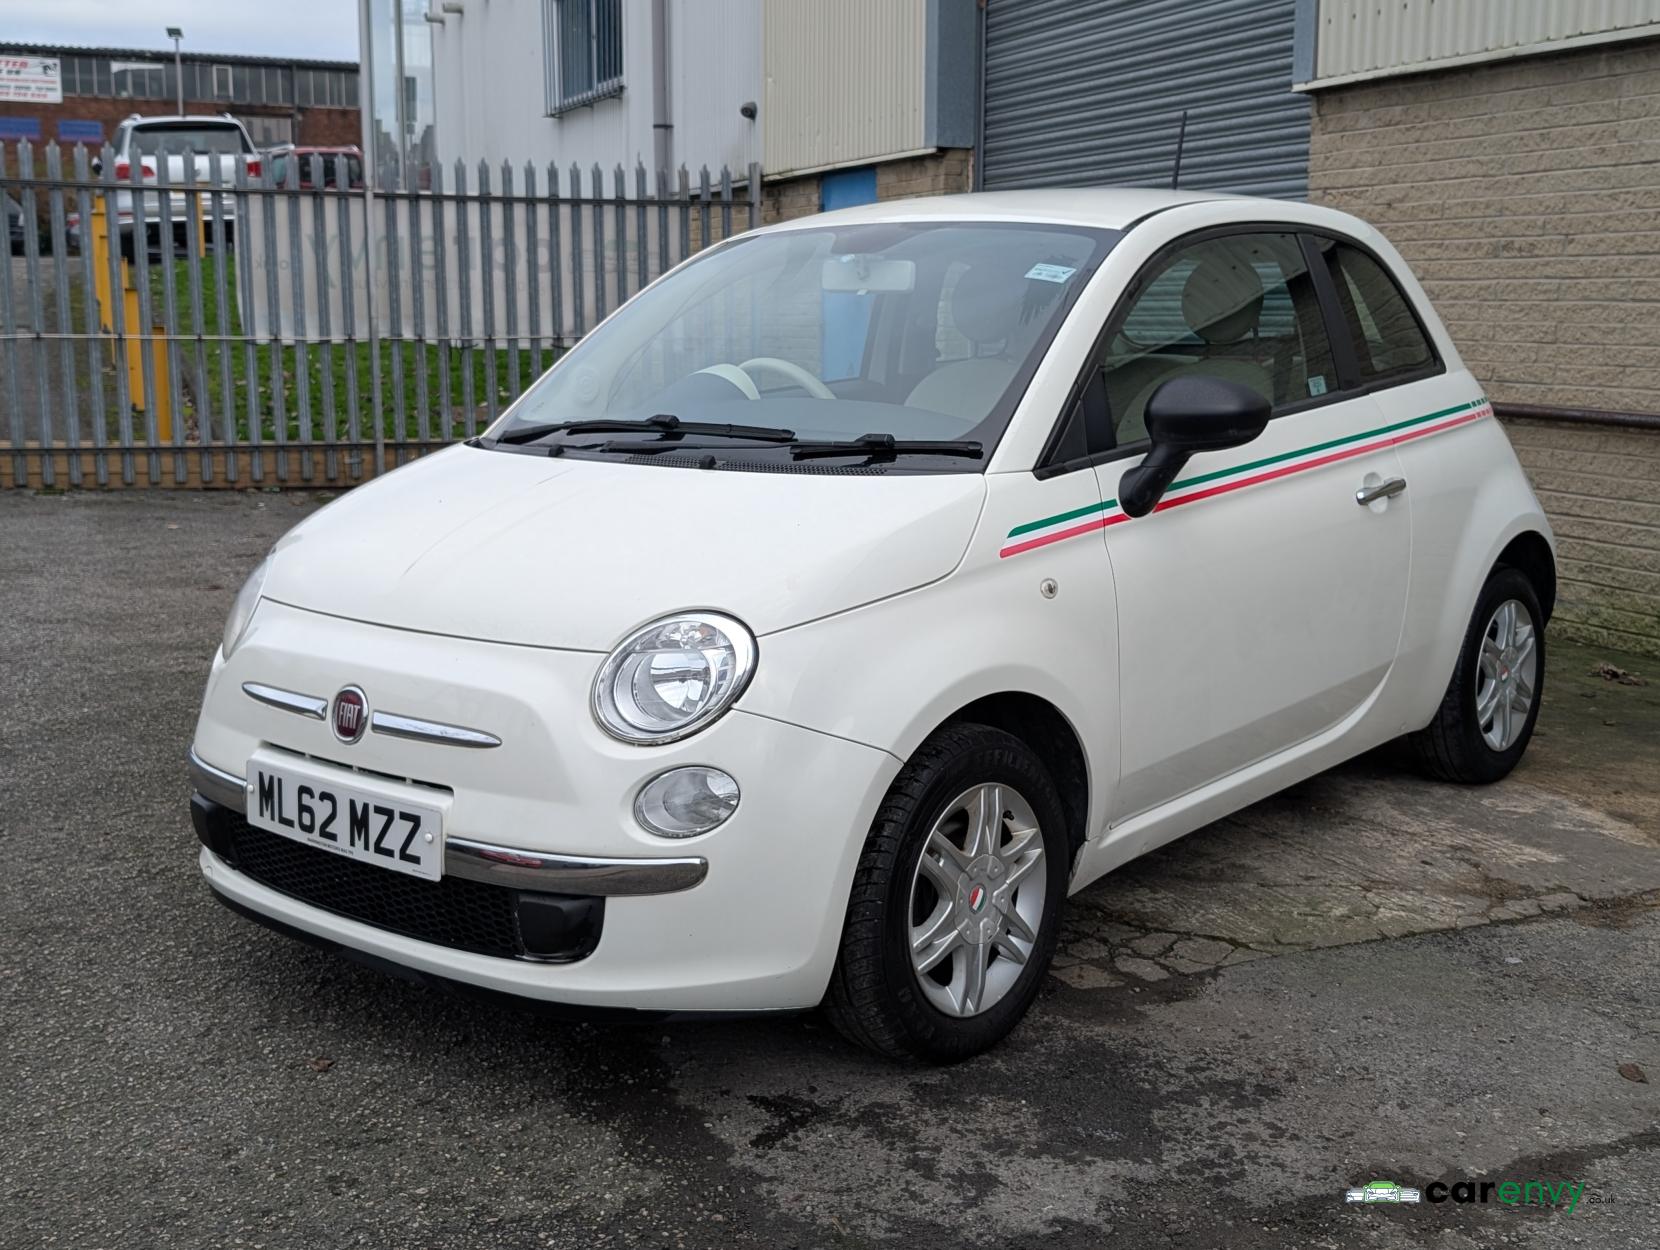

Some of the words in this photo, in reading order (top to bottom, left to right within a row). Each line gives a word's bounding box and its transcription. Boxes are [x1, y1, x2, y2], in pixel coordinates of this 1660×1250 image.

[338, 701, 361, 729] FIAT
[258, 770, 338, 843] ML62
[349, 798, 422, 866] MZZ
